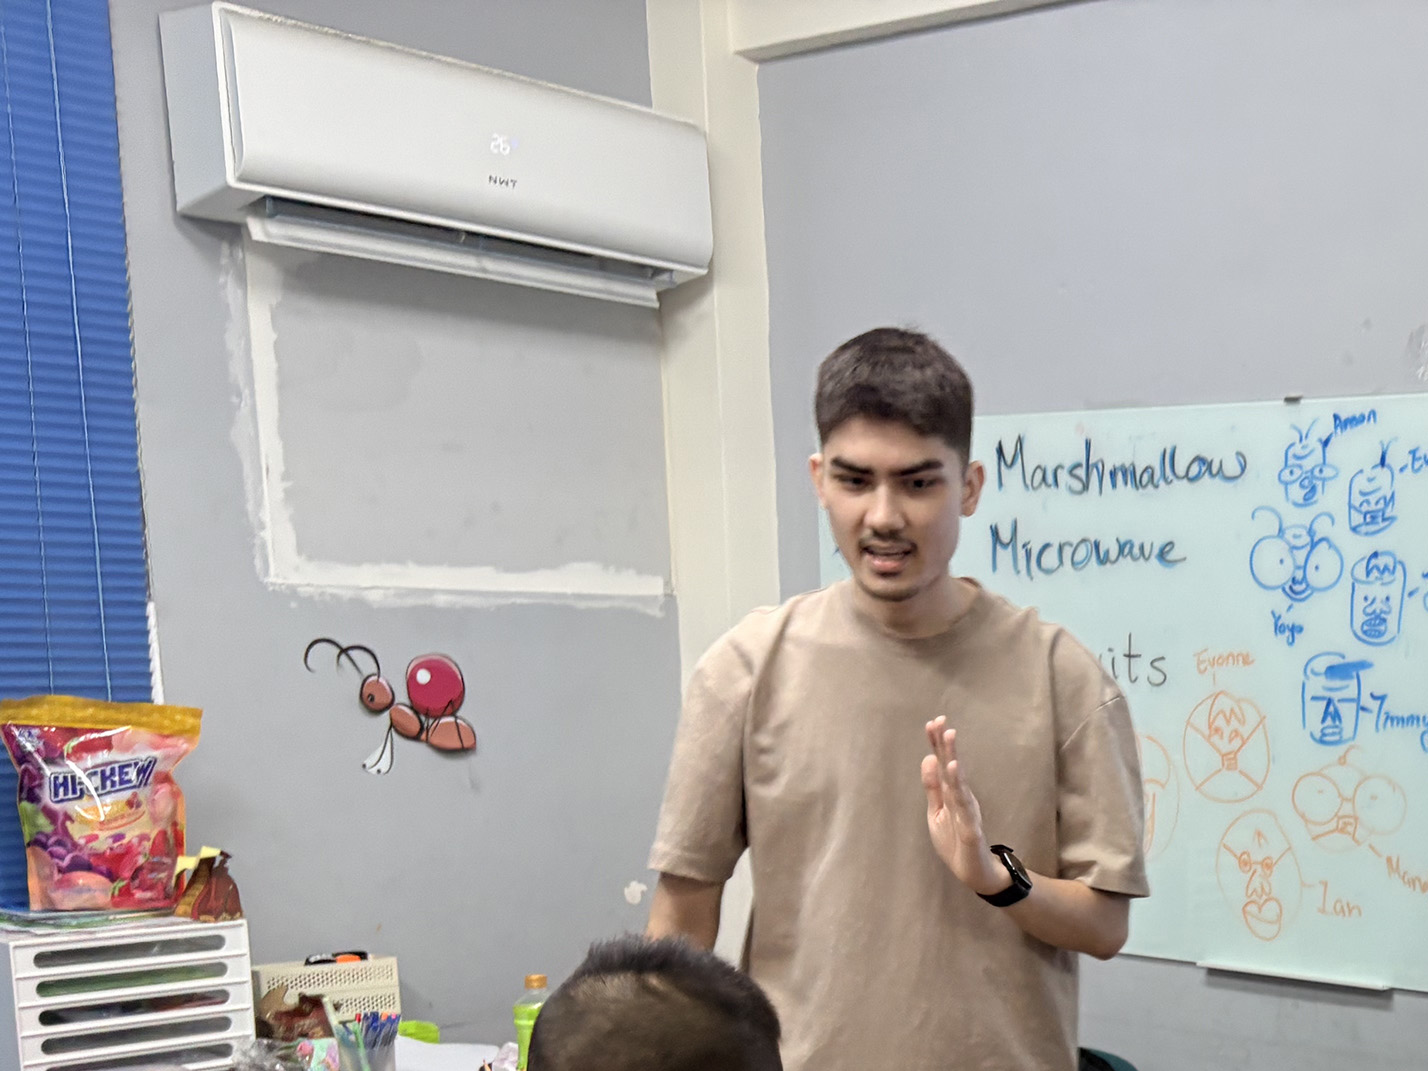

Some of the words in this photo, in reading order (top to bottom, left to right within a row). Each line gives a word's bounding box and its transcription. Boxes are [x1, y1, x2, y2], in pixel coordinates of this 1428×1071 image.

[995, 434, 1248, 496] Marshmallow
[989, 518, 1187, 581] Microwave
[1099, 632, 1168, 687] its
[1193, 647, 1256, 676] Evonne
[1317, 881, 1362, 917] Ian
